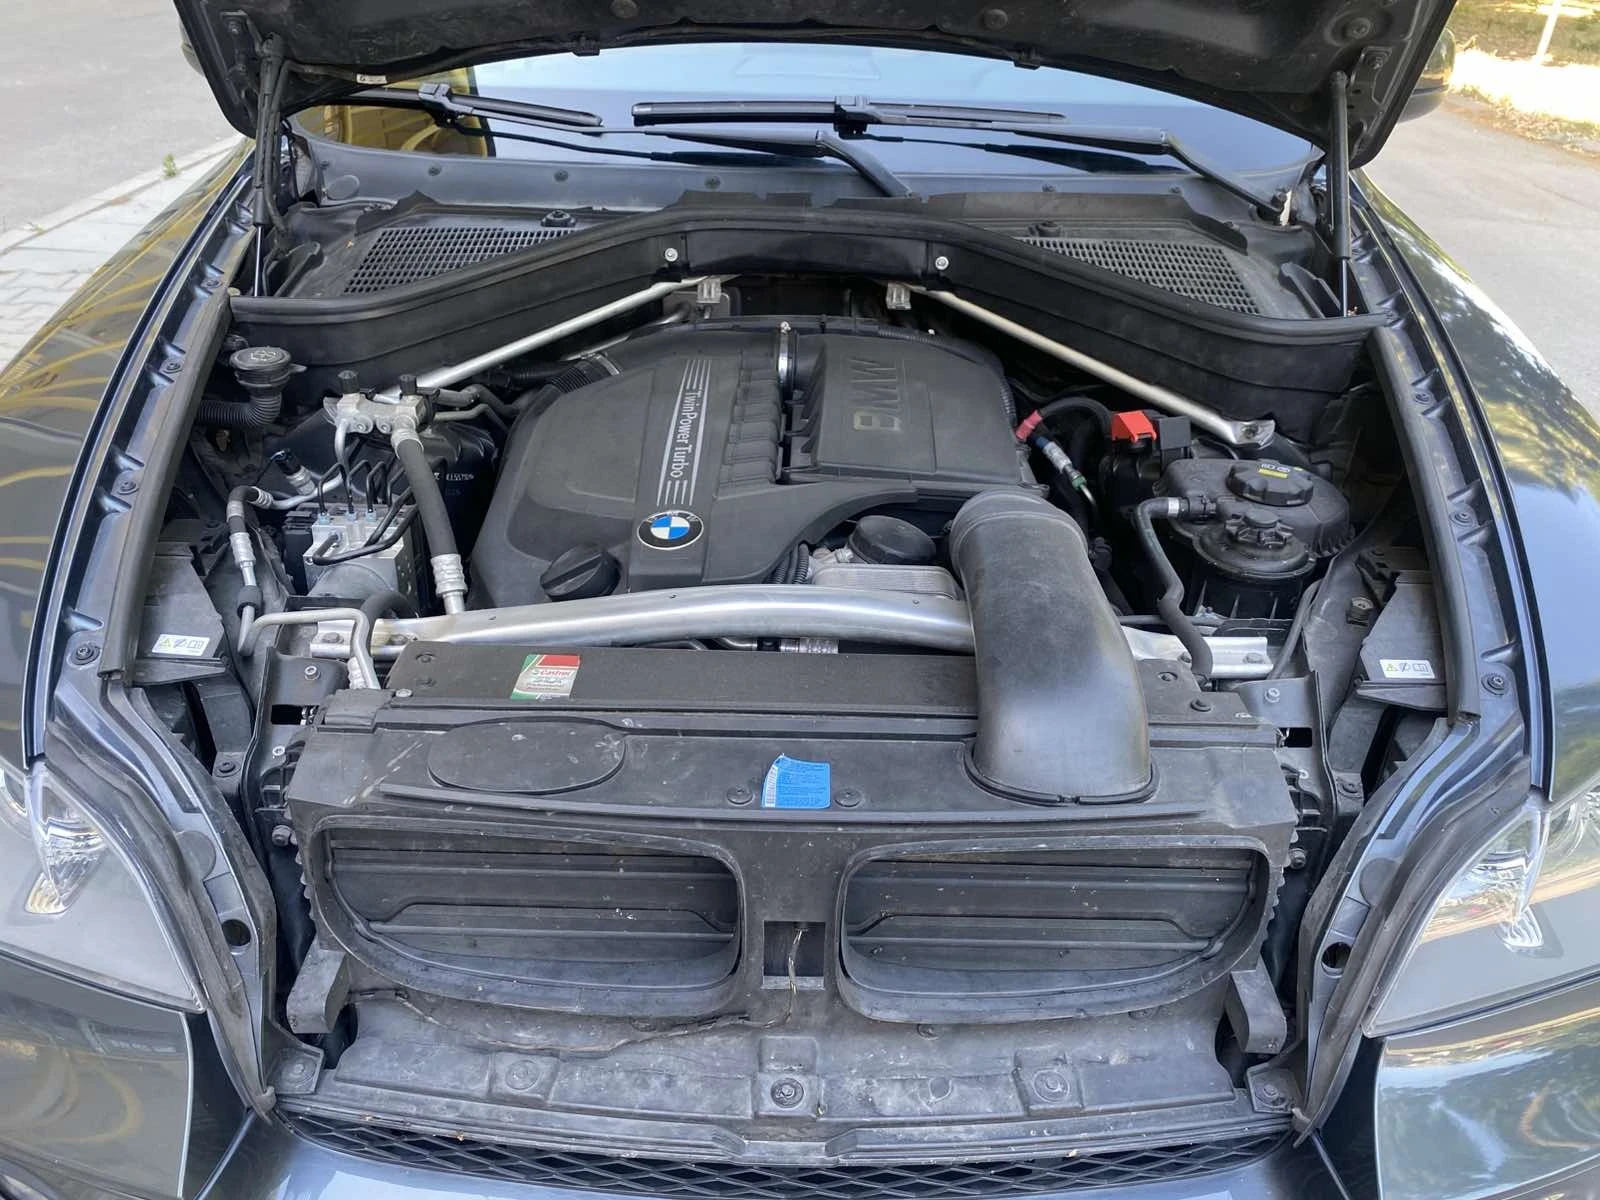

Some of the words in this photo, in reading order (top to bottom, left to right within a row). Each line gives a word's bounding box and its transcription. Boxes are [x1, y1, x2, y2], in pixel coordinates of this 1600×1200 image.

[676, 390, 702, 444] TwinPower
[850, 359, 901, 431] BMW
[670, 444, 693, 478] Turbo
